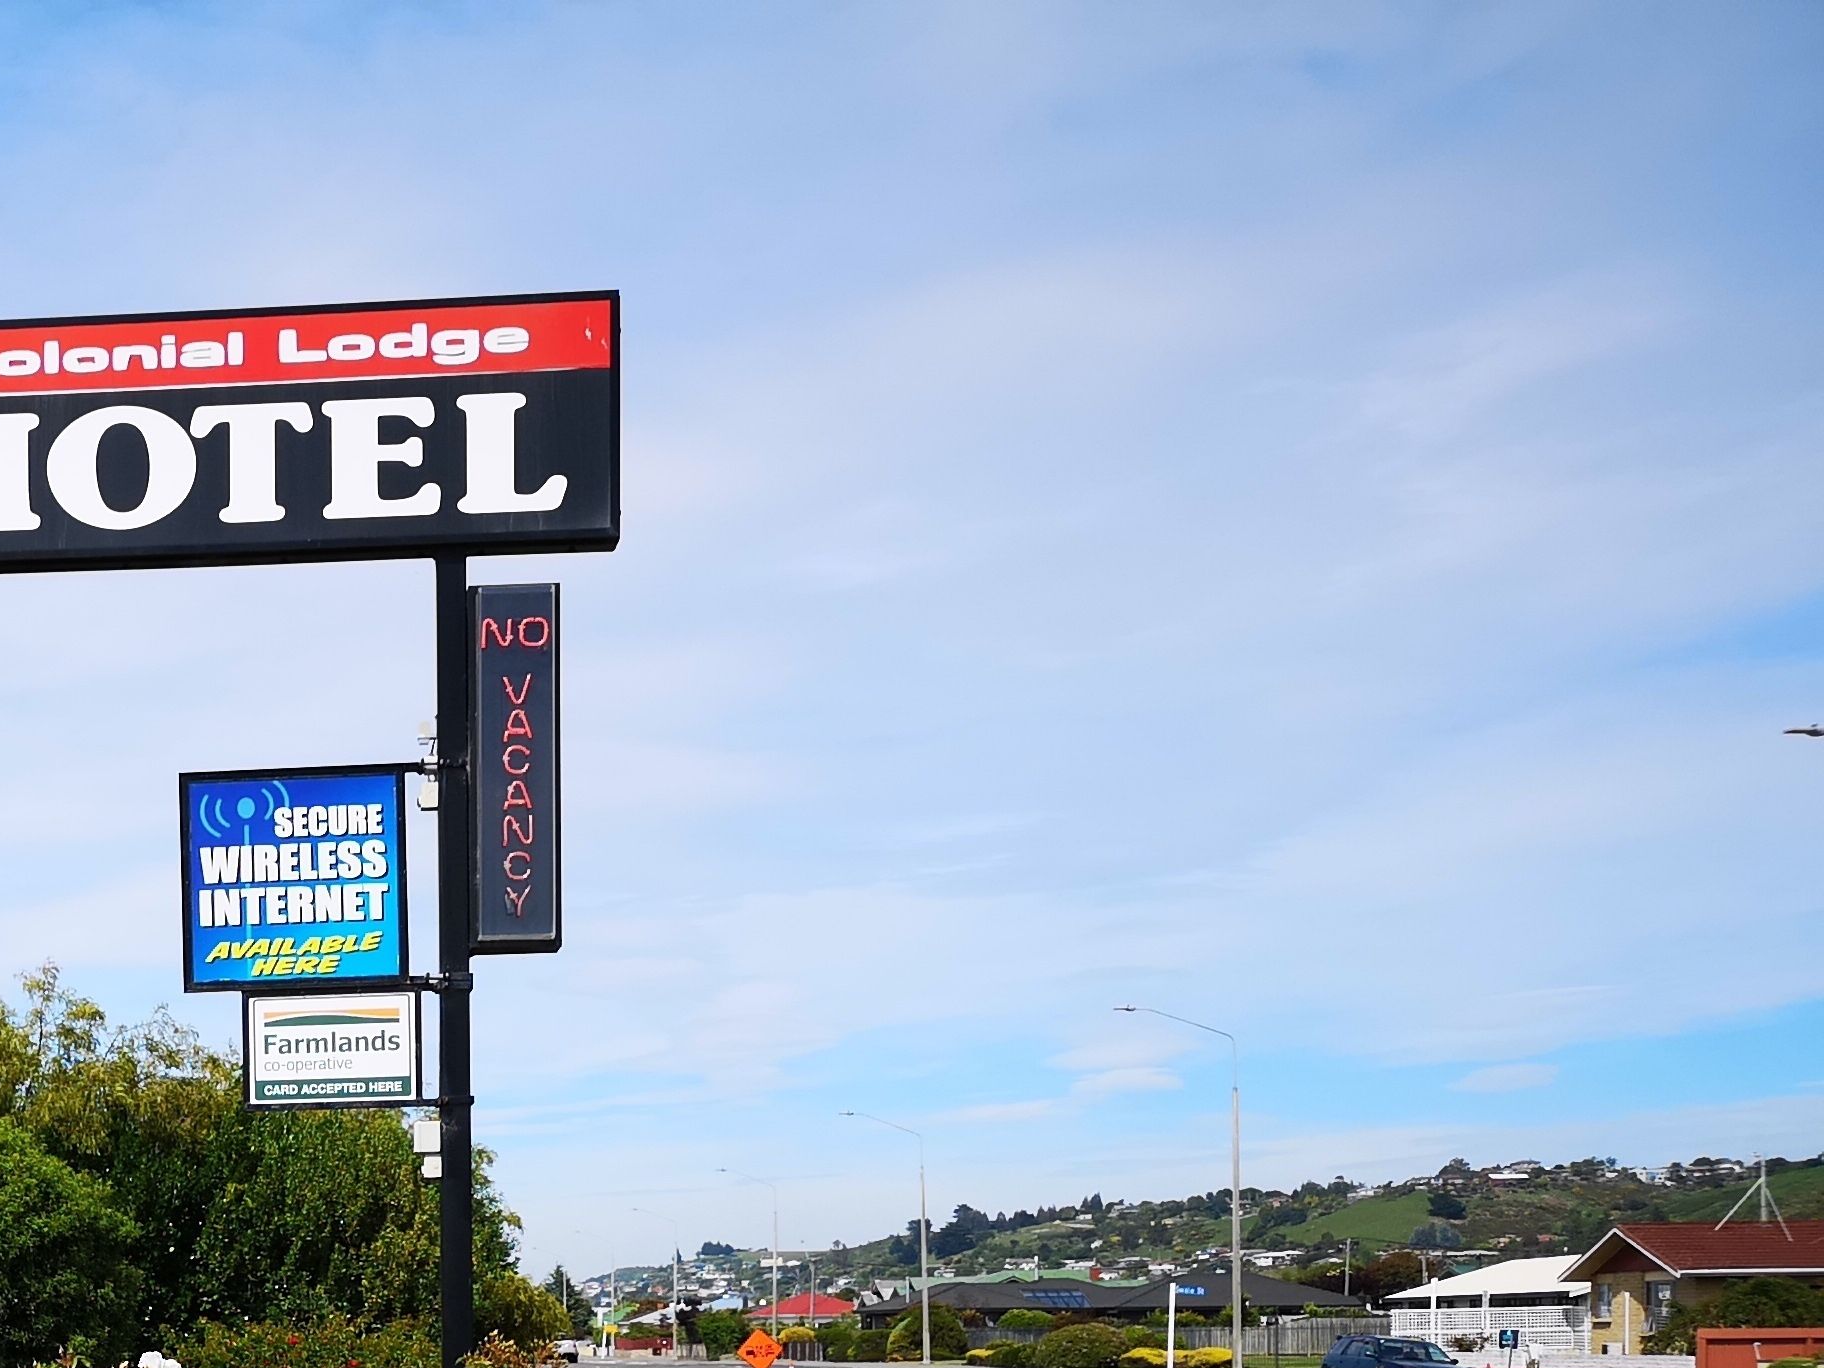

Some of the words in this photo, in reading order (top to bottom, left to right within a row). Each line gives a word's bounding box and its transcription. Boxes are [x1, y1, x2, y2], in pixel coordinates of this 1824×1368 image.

[278, 322, 530, 365] Lodge
[480, 616, 550, 649] NO
[502, 672, 534, 918] VACANCY
[273, 804, 384, 838] SECURE
[199, 839, 388, 885] WIRELESS
[198, 882, 389, 927] INTERNET
[205, 930, 383, 963] AVAILABLE
[251, 954, 341, 977] HERE
[263, 1029, 401, 1055] Farmlands
[263, 1056, 353, 1074] co-operative
[263, 1084, 299, 1096] CARD
[301, 1082, 366, 1095] ACCEPTED
[369, 1080, 403, 1093] HERE
